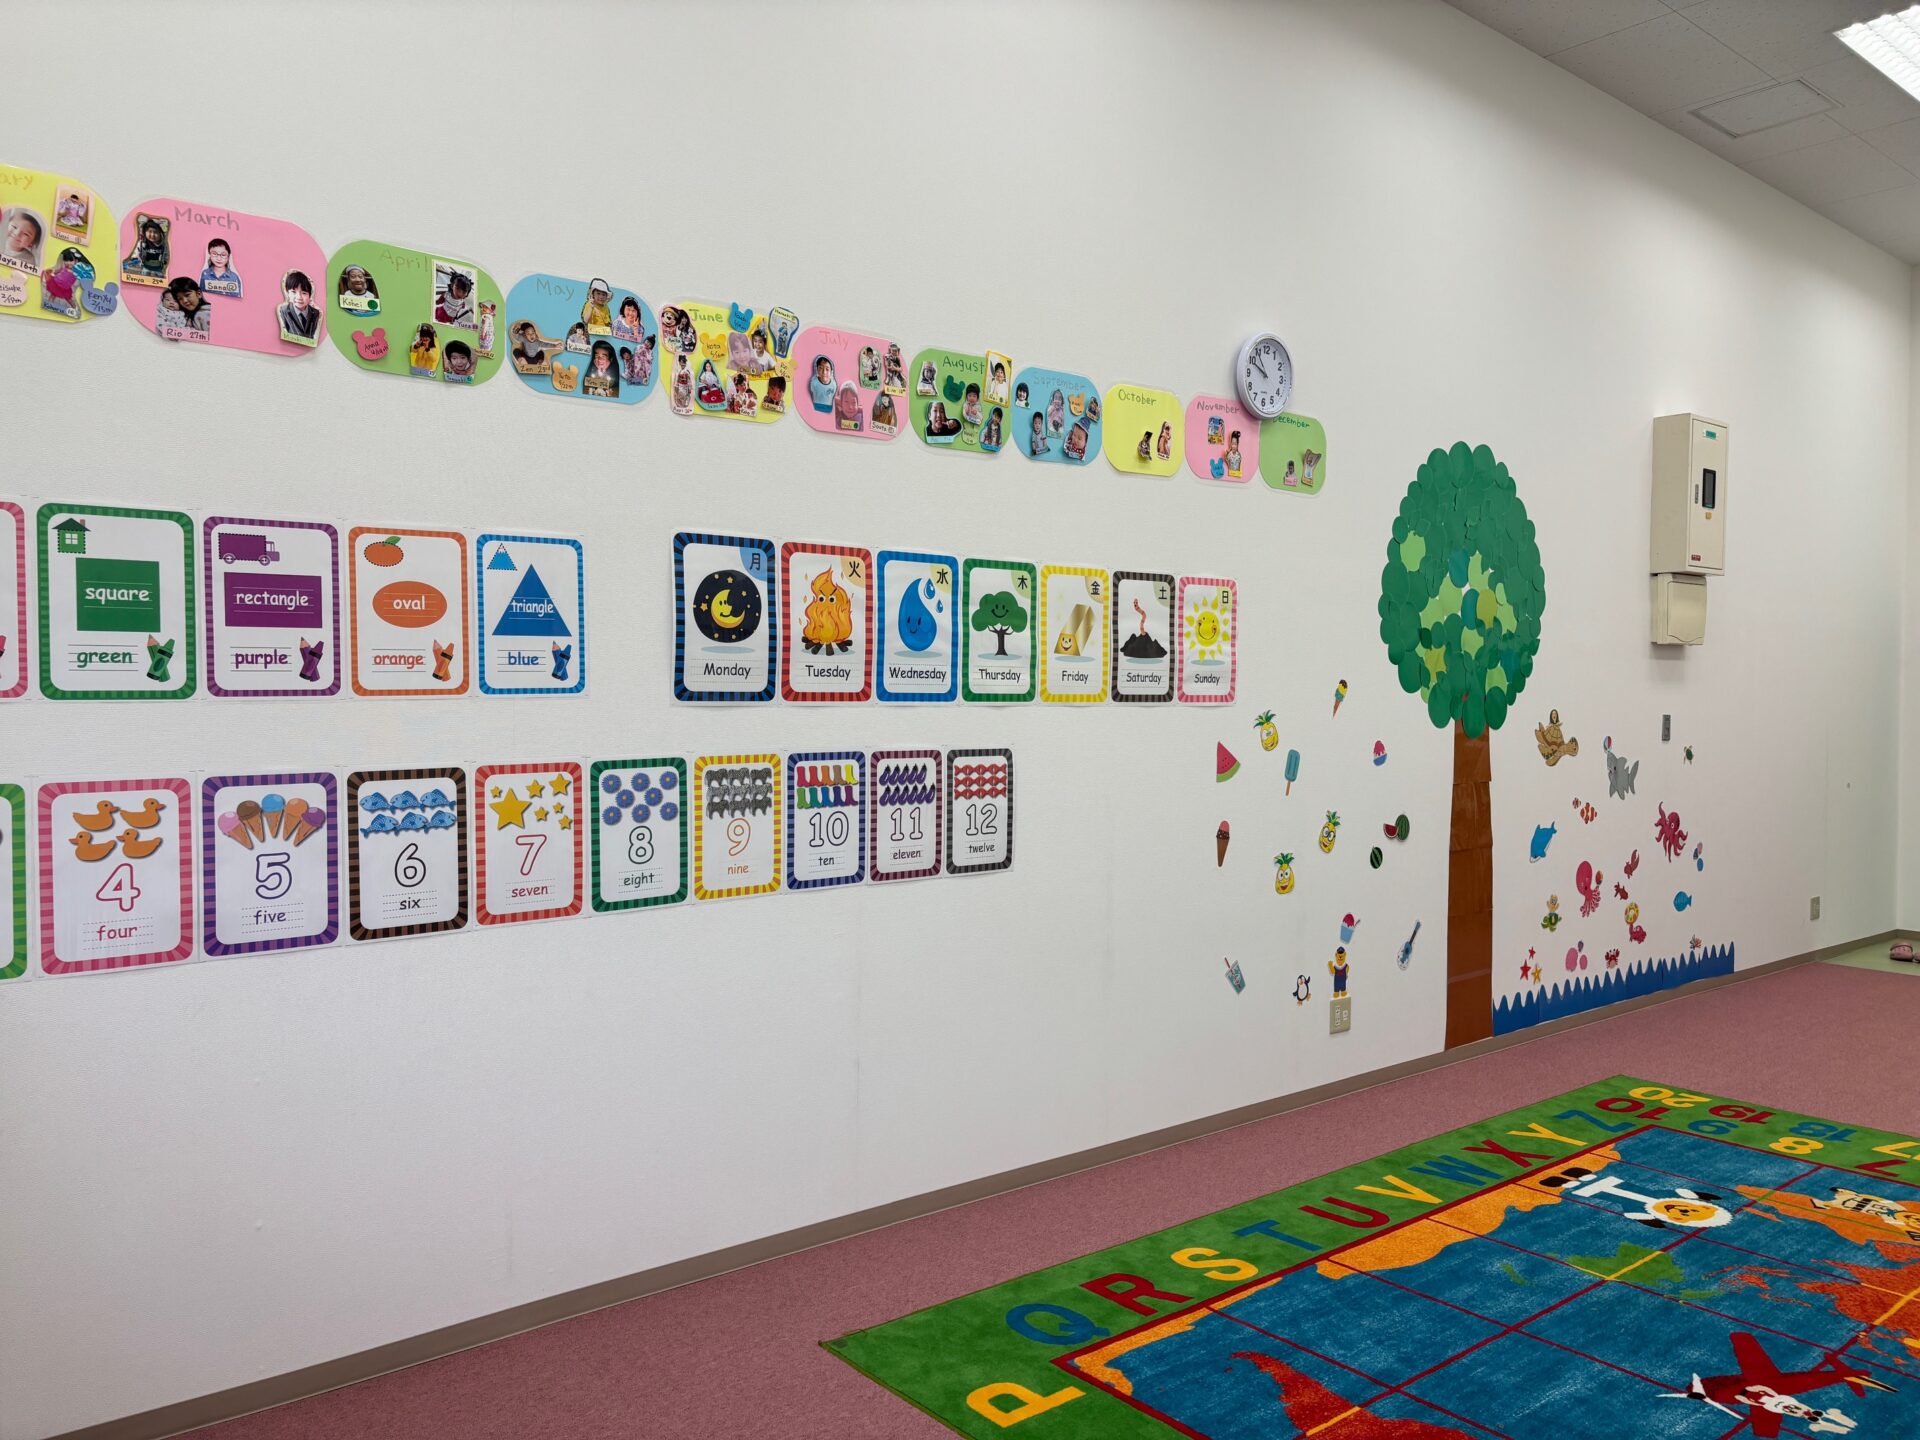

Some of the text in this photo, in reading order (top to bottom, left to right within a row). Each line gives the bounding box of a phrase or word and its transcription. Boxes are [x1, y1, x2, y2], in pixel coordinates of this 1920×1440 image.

[174, 207, 239, 231] March
[380, 250, 428, 272] April
[536, 278, 575, 301] May
[689, 308, 724, 323] June
[166, 328, 183, 339] Rio
[819, 331, 849, 351] July
[1263, 345, 1271, 355] 12
[942, 355, 985, 375] August
[1246, 368, 1251, 377] 9
[1277, 362, 1283, 371] 2
[1248, 381, 1253, 391] 8
[1279, 375, 1284, 385] 3
[1118, 389, 1157, 406] October
[1253, 392, 1258, 401] 7
[1269, 396, 1275, 405] 5
[1275, 388, 1280, 397] 4
[1197, 401, 1241, 414] November
[1261, 397, 1266, 407] 6
[749, 552, 761, 571] 月
[848, 560, 862, 578] 火
[936, 568, 949, 585] 水
[1017, 575, 1028, 590] 木
[85, 587, 150, 605] square
[1091, 580, 1101, 596] 金
[1158, 586, 1167, 600] 土
[236, 590, 309, 610] rectangle
[393, 595, 426, 610] oval
[1221, 590, 1229, 604] 日
[511, 599, 554, 617] triangle
[77, 651, 133, 668] green
[235, 649, 288, 669] purple
[373, 654, 424, 669] orange
[508, 652, 539, 666] blue
[703, 662, 751, 680] Monday
[805, 664, 851, 681] Tuesday
[889, 666, 947, 683] Wednesday
[978, 668, 1021, 683] Thursday
[1061, 670, 1089, 684] Friday
[1126, 672, 1162, 685] Saturday
[1194, 673, 1221, 686] Sunday
[890, 806, 923, 842] 11
[965, 803, 998, 836] 12
[726, 817, 751, 857] 9
[809, 811, 849, 848] 10
[628, 825, 654, 865] 8
[968, 842, 996, 854] twelve
[515, 834, 548, 876] 7
[818, 856, 835, 867] ten
[892, 849, 921, 860] eleven
[394, 842, 427, 888] 6
[727, 863, 749, 876] nine
[255, 851, 292, 900] 5
[623, 872, 655, 889] eight
[96, 862, 141, 912] 4
[511, 885, 549, 898] seven
[399, 897, 421, 911] six
[253, 909, 287, 926] five
[96, 924, 138, 942] four
[1628, 1086, 1712, 1108] 20
[1595, 1097, 1671, 1121] 10
[1554, 1109, 1637, 1133] Z
[1506, 1122, 1588, 1147] Y
[1461, 1138, 1554, 1168] X
[1768, 1136, 1824, 1155] 8
[1407, 1154, 1504, 1187] W
[1354, 1174, 1443, 1205] V
[1299, 1196, 1391, 1229] U
[1232, 1219, 1323, 1252] T
[1170, 1247, 1260, 1282] S
[1079, 1272, 1196, 1318] R
[1005, 1303, 1111, 1346] Q
[965, 1381, 1087, 1428] P
